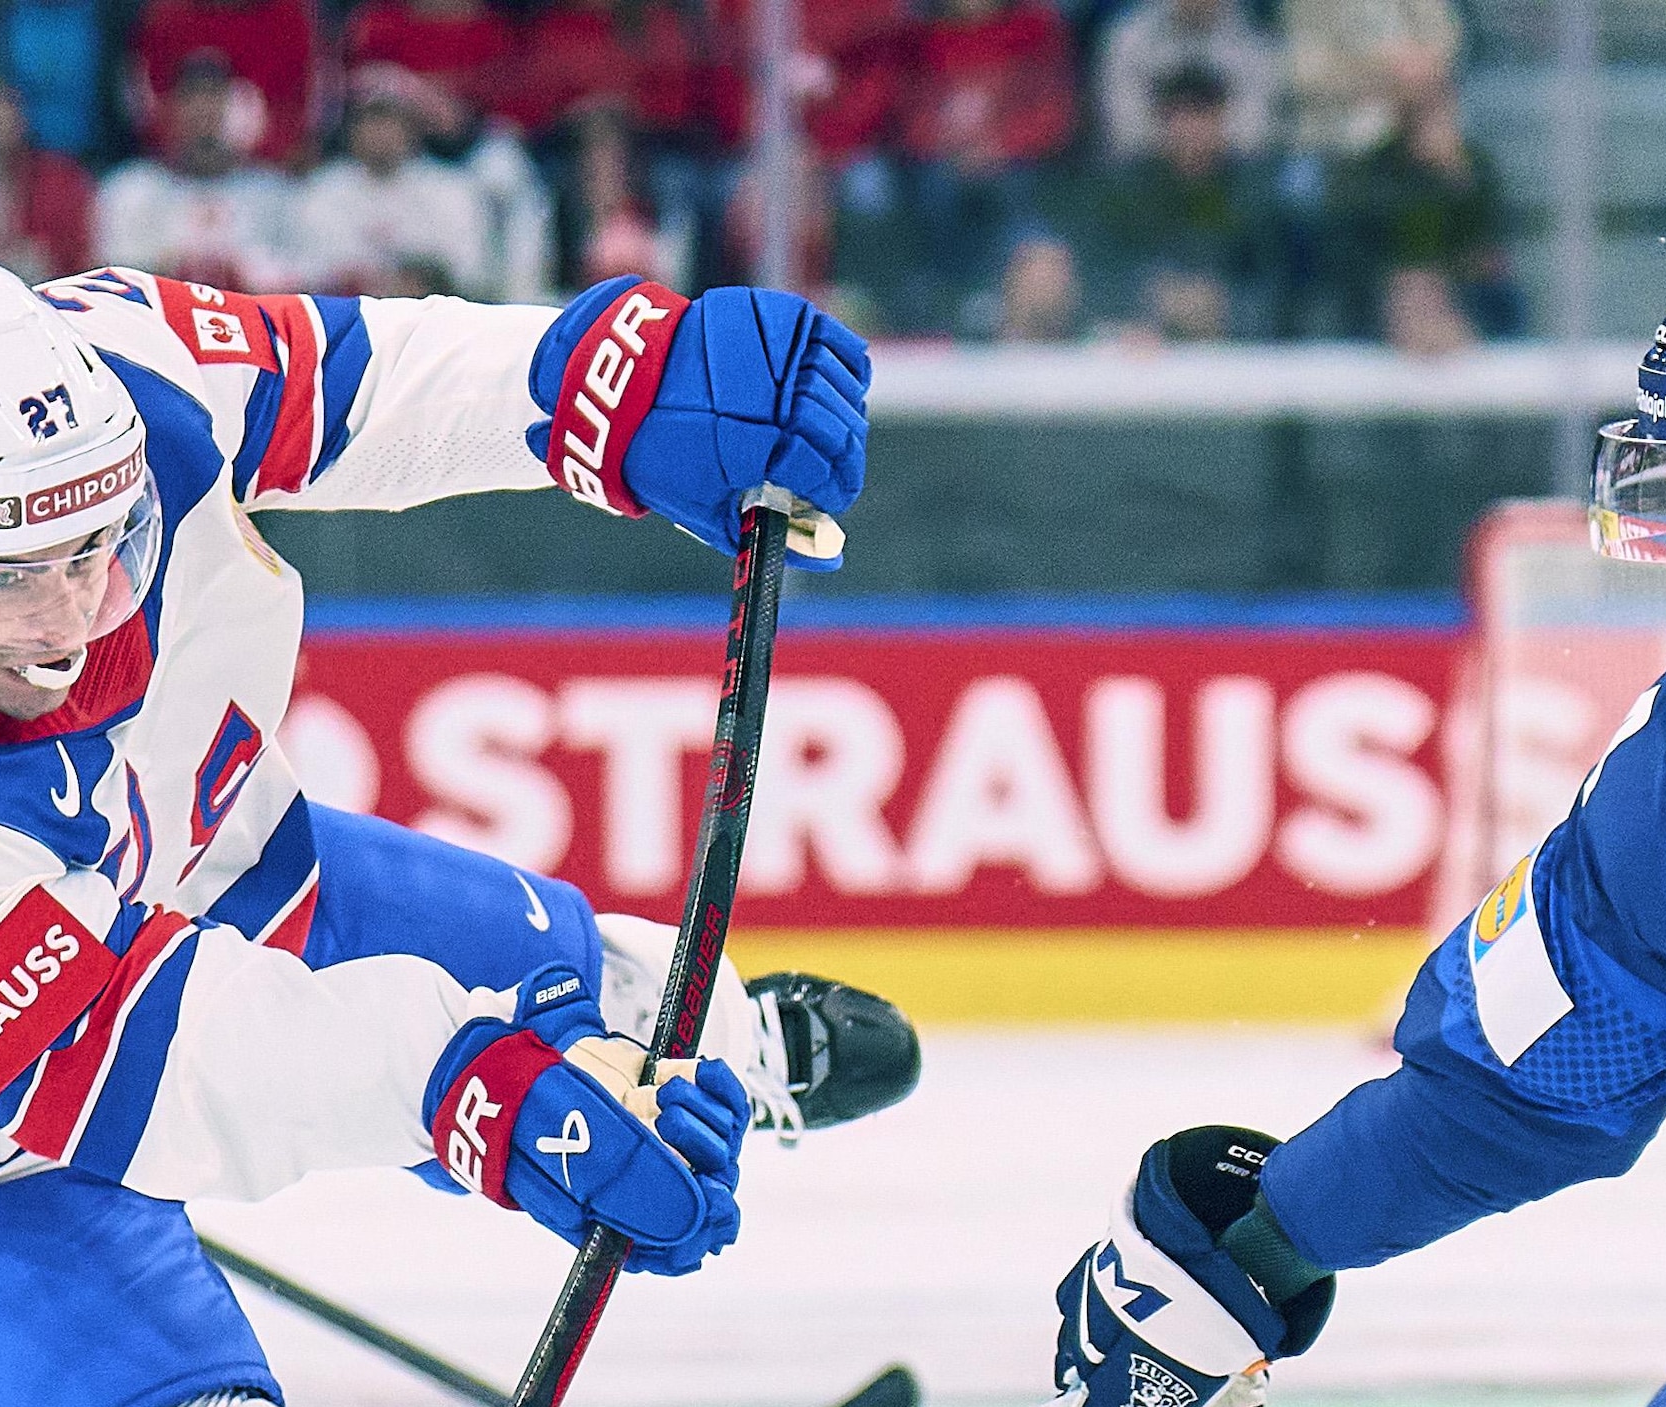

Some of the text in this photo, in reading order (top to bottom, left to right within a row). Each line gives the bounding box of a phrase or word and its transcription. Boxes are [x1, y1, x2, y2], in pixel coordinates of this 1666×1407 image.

[18, 383, 79, 441] 27
[535, 977, 580, 1005] BAUER
[1137, 1359, 1191, 1402] SUOMI
